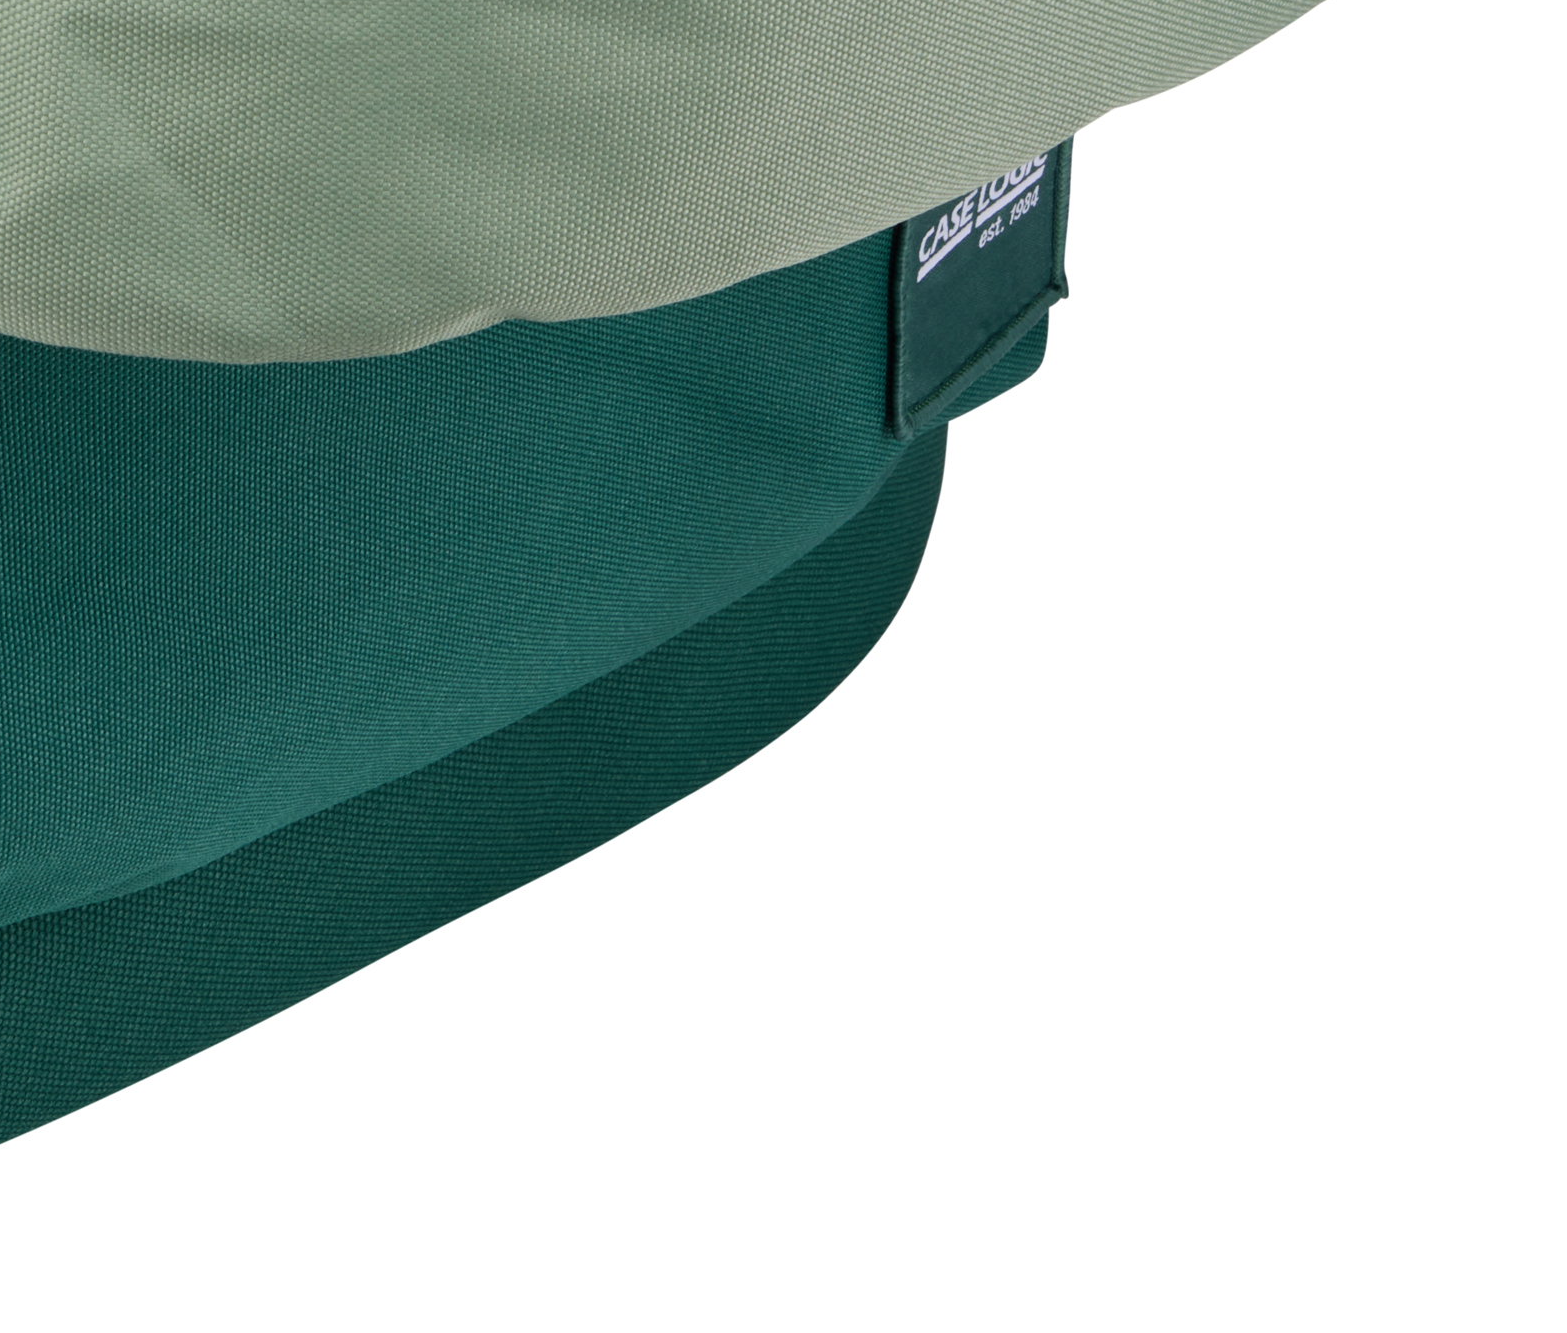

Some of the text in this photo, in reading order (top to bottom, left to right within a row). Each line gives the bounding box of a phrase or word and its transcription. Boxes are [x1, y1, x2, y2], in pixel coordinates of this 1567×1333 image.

[918, 188, 979, 263] CASE
[978, 184, 1040, 249] est. 1984
